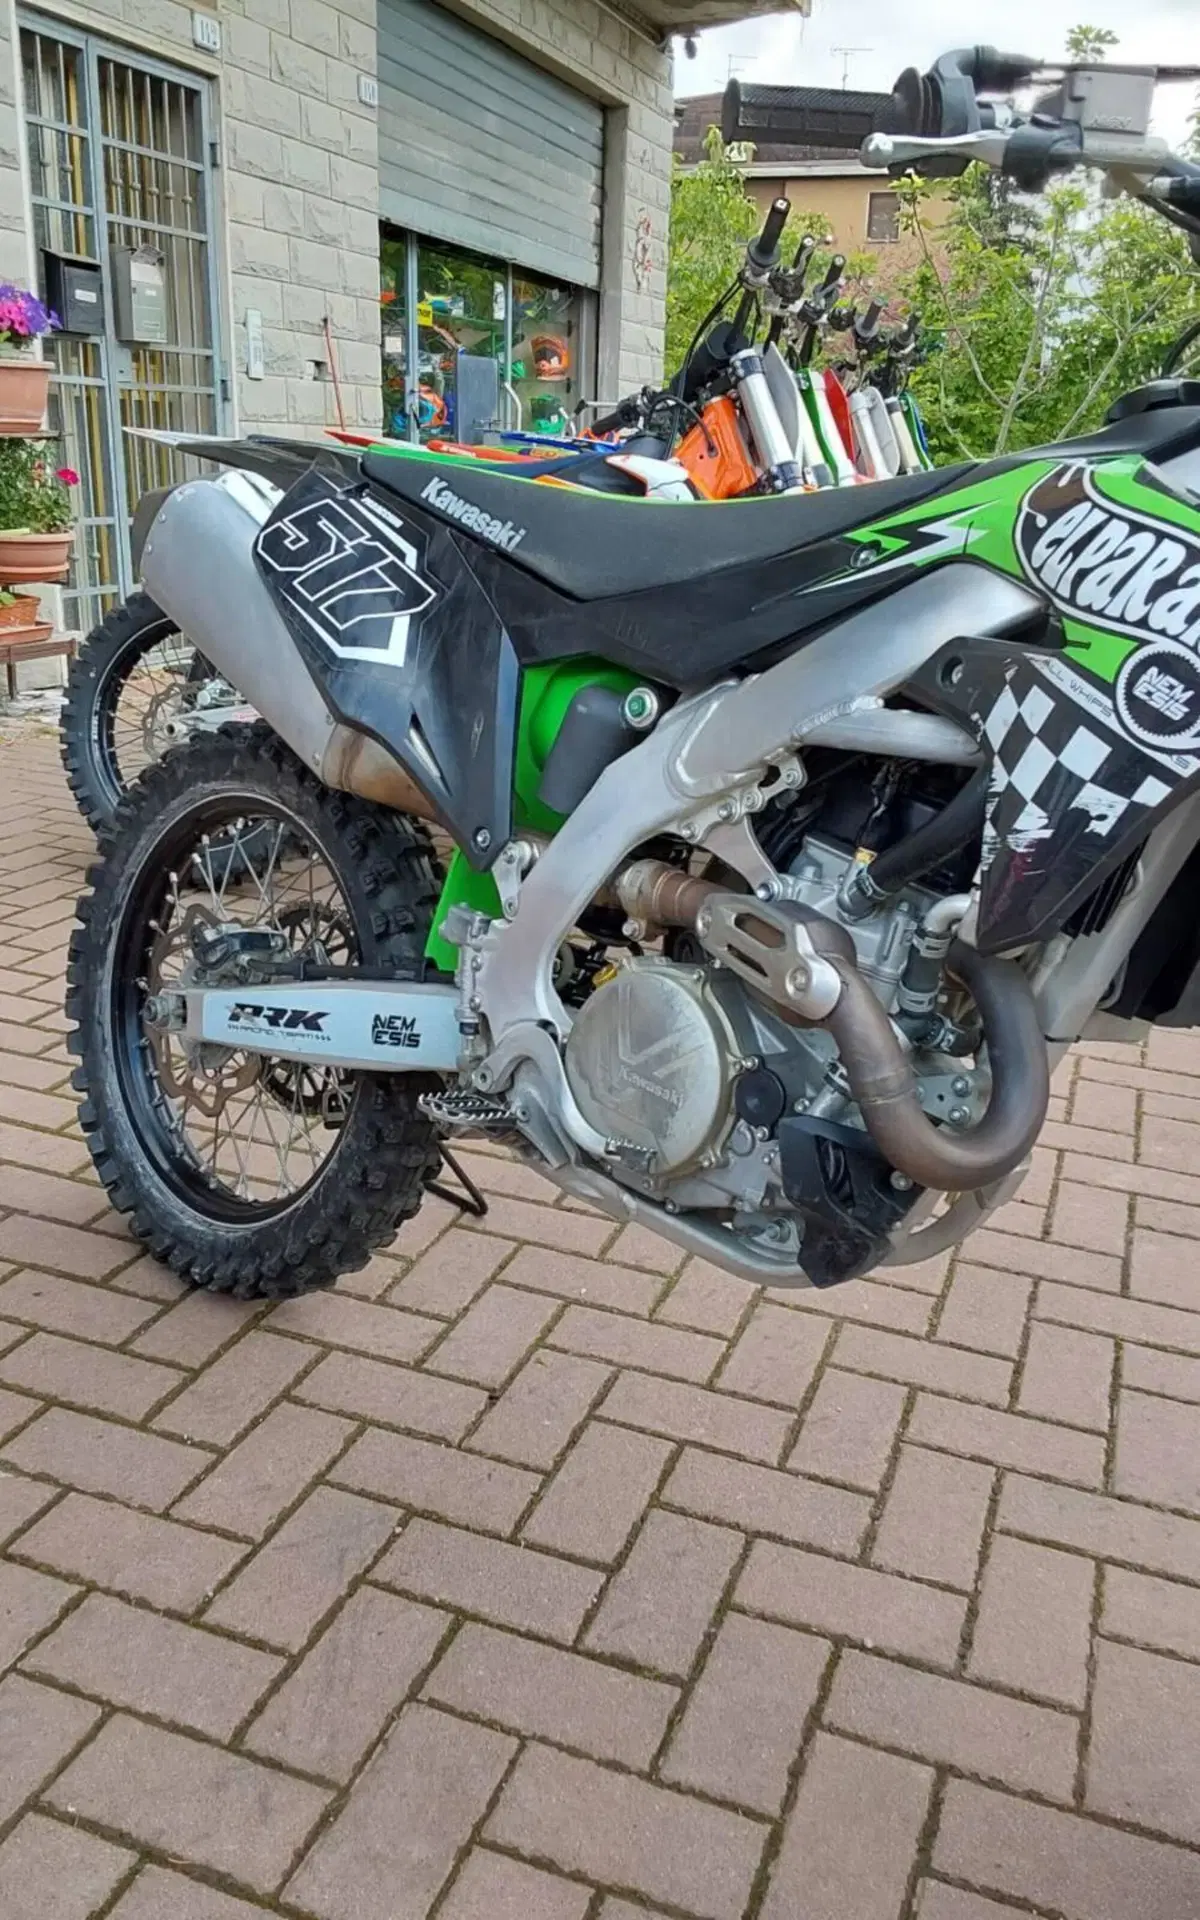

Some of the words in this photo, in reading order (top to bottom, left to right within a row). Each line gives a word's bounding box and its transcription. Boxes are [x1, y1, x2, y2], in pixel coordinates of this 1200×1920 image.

[420, 476, 527, 552] Kawasaki
[257, 498, 437, 630] 517
[372, 1028, 422, 1048] ESIS
[373, 1013, 417, 1032] NEM
